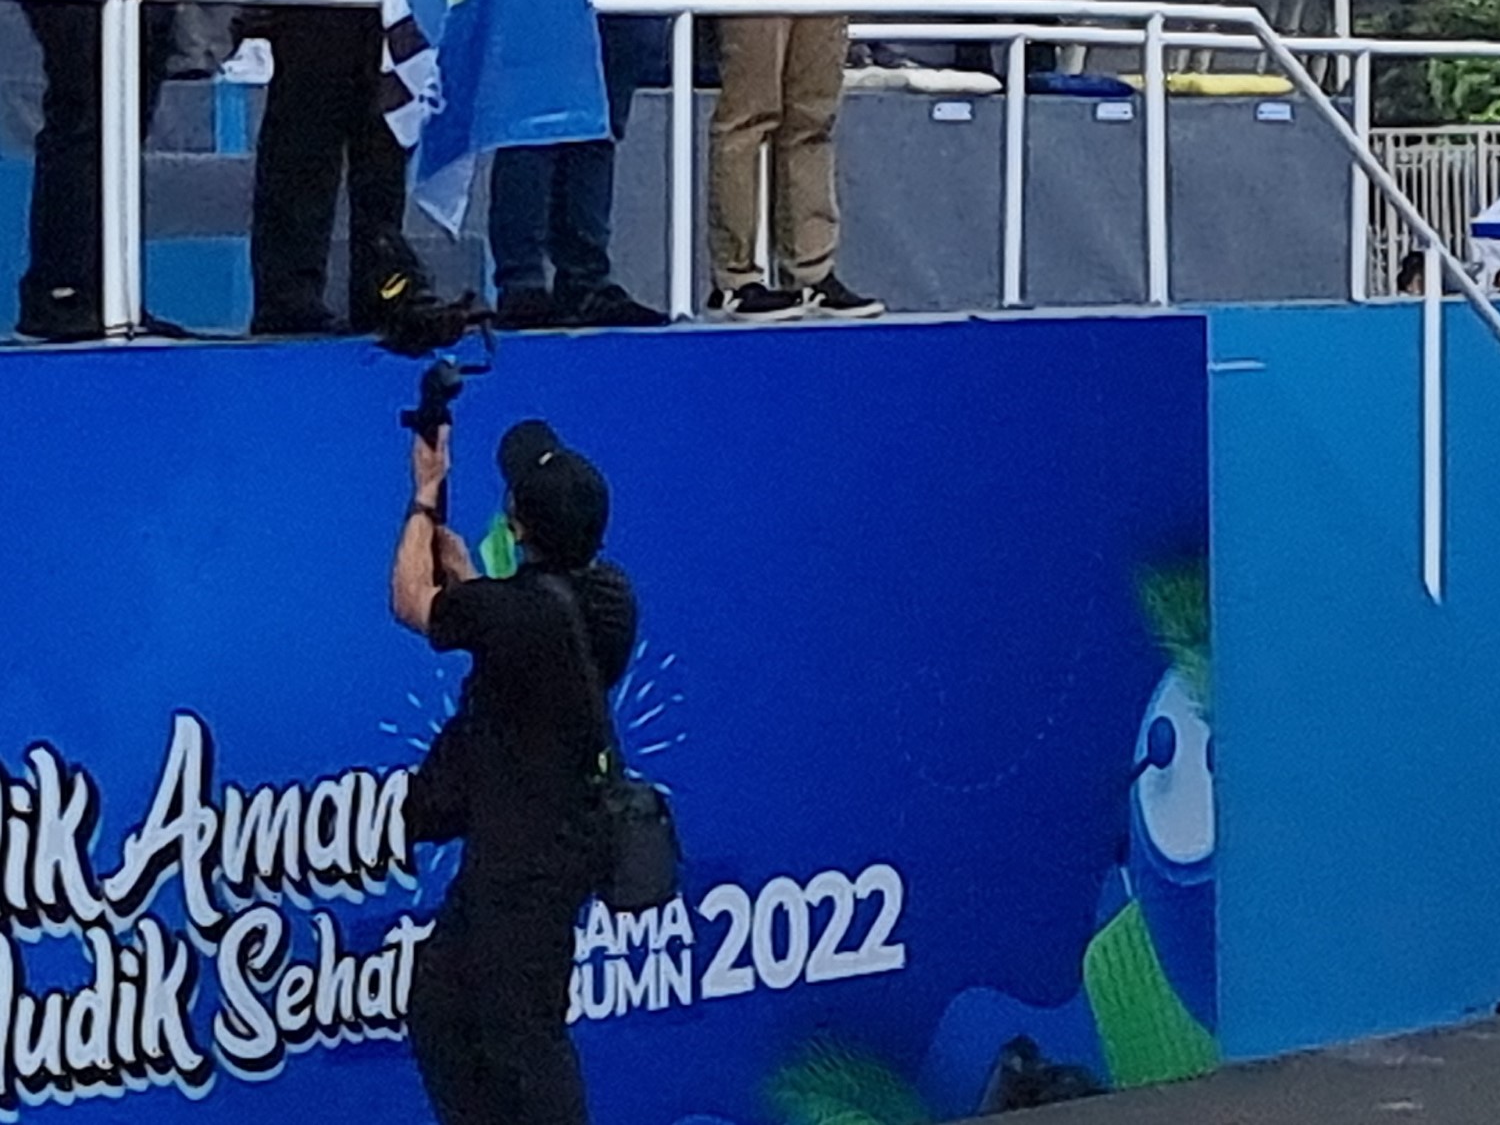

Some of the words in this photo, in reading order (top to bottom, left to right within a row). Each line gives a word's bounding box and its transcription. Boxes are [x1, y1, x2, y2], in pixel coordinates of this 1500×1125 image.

[104, 714, 410, 928] Aman
[0, 916, 204, 1094] udik
[214, 904, 437, 1059] Sehat
[696, 863, 905, 1000] 2022
